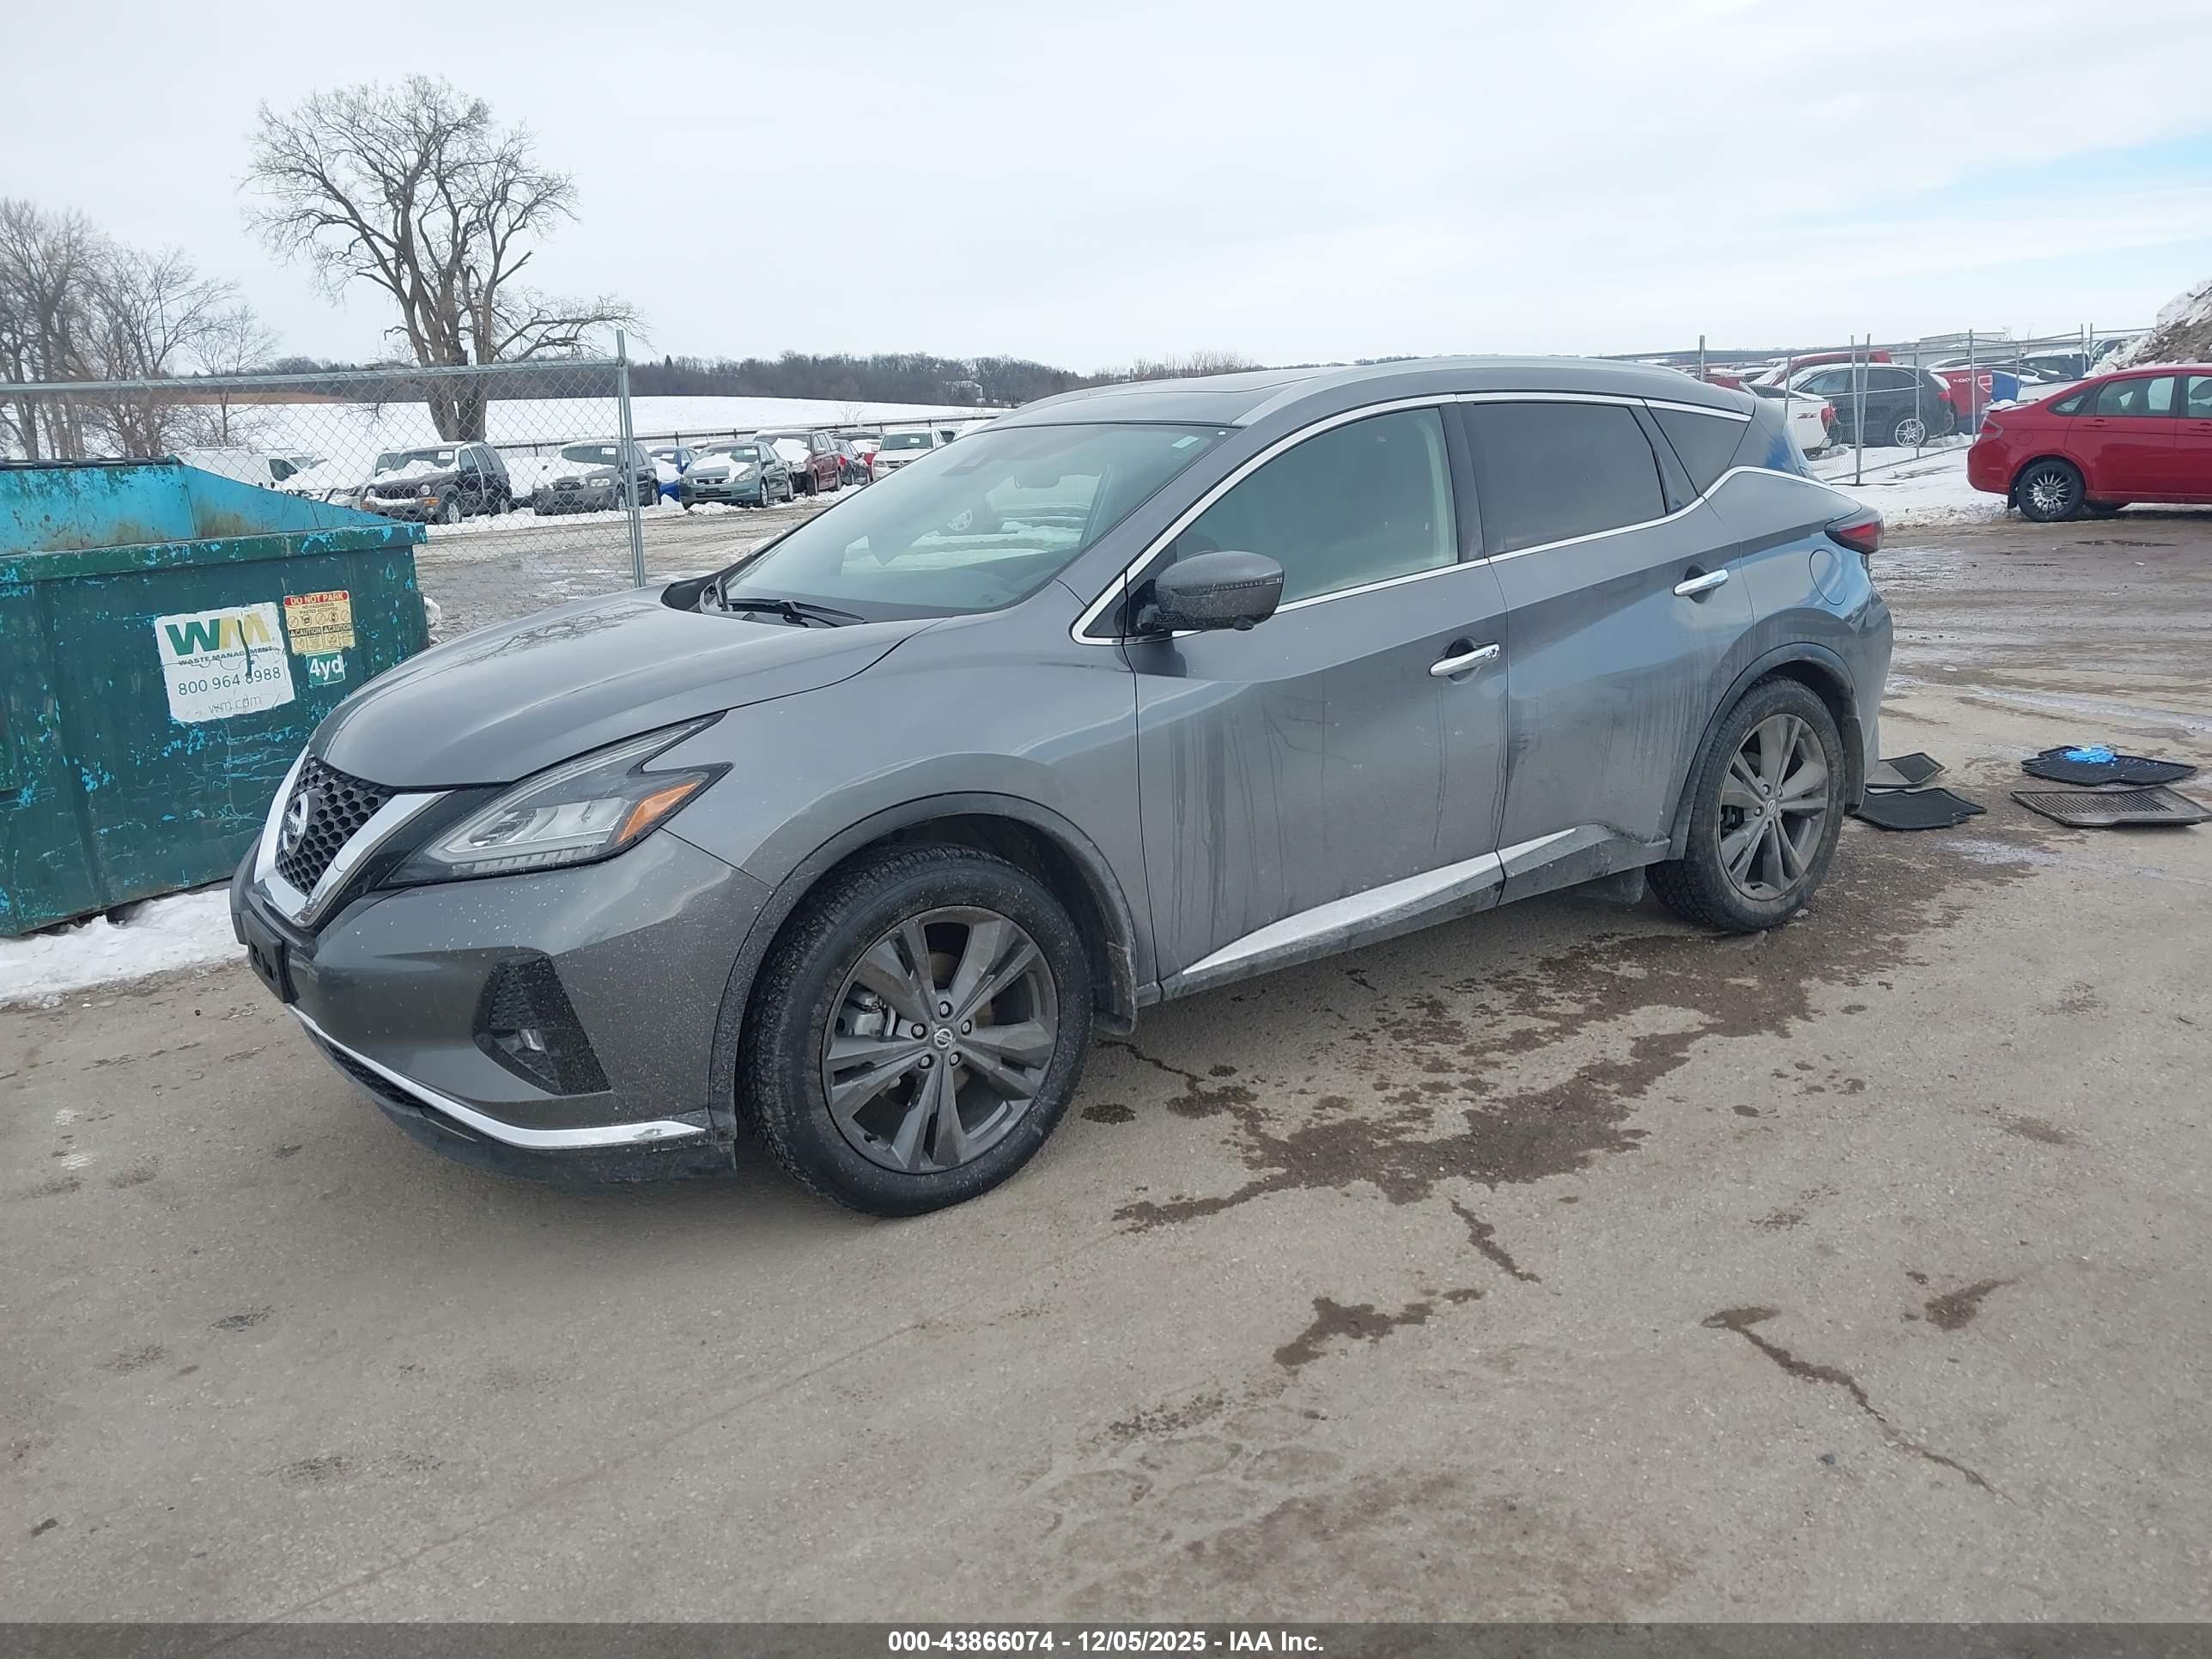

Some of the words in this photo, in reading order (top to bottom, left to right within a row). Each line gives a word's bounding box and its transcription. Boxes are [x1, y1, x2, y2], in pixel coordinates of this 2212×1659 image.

[304, 595, 321, 604] NOT
[322, 592, 344, 602] PARK
[165, 611, 270, 656] WM
[295, 627, 321, 636] CAUTION
[328, 623, 352, 633] CAUTION
[179, 656, 210, 665] WASTE
[212, 646, 274, 660] MANAGMENT
[310, 654, 343, 680] 4yd
[179, 679, 208, 696] 800
[212, 673, 240, 690] 964
[245, 666, 281, 684] 8988
